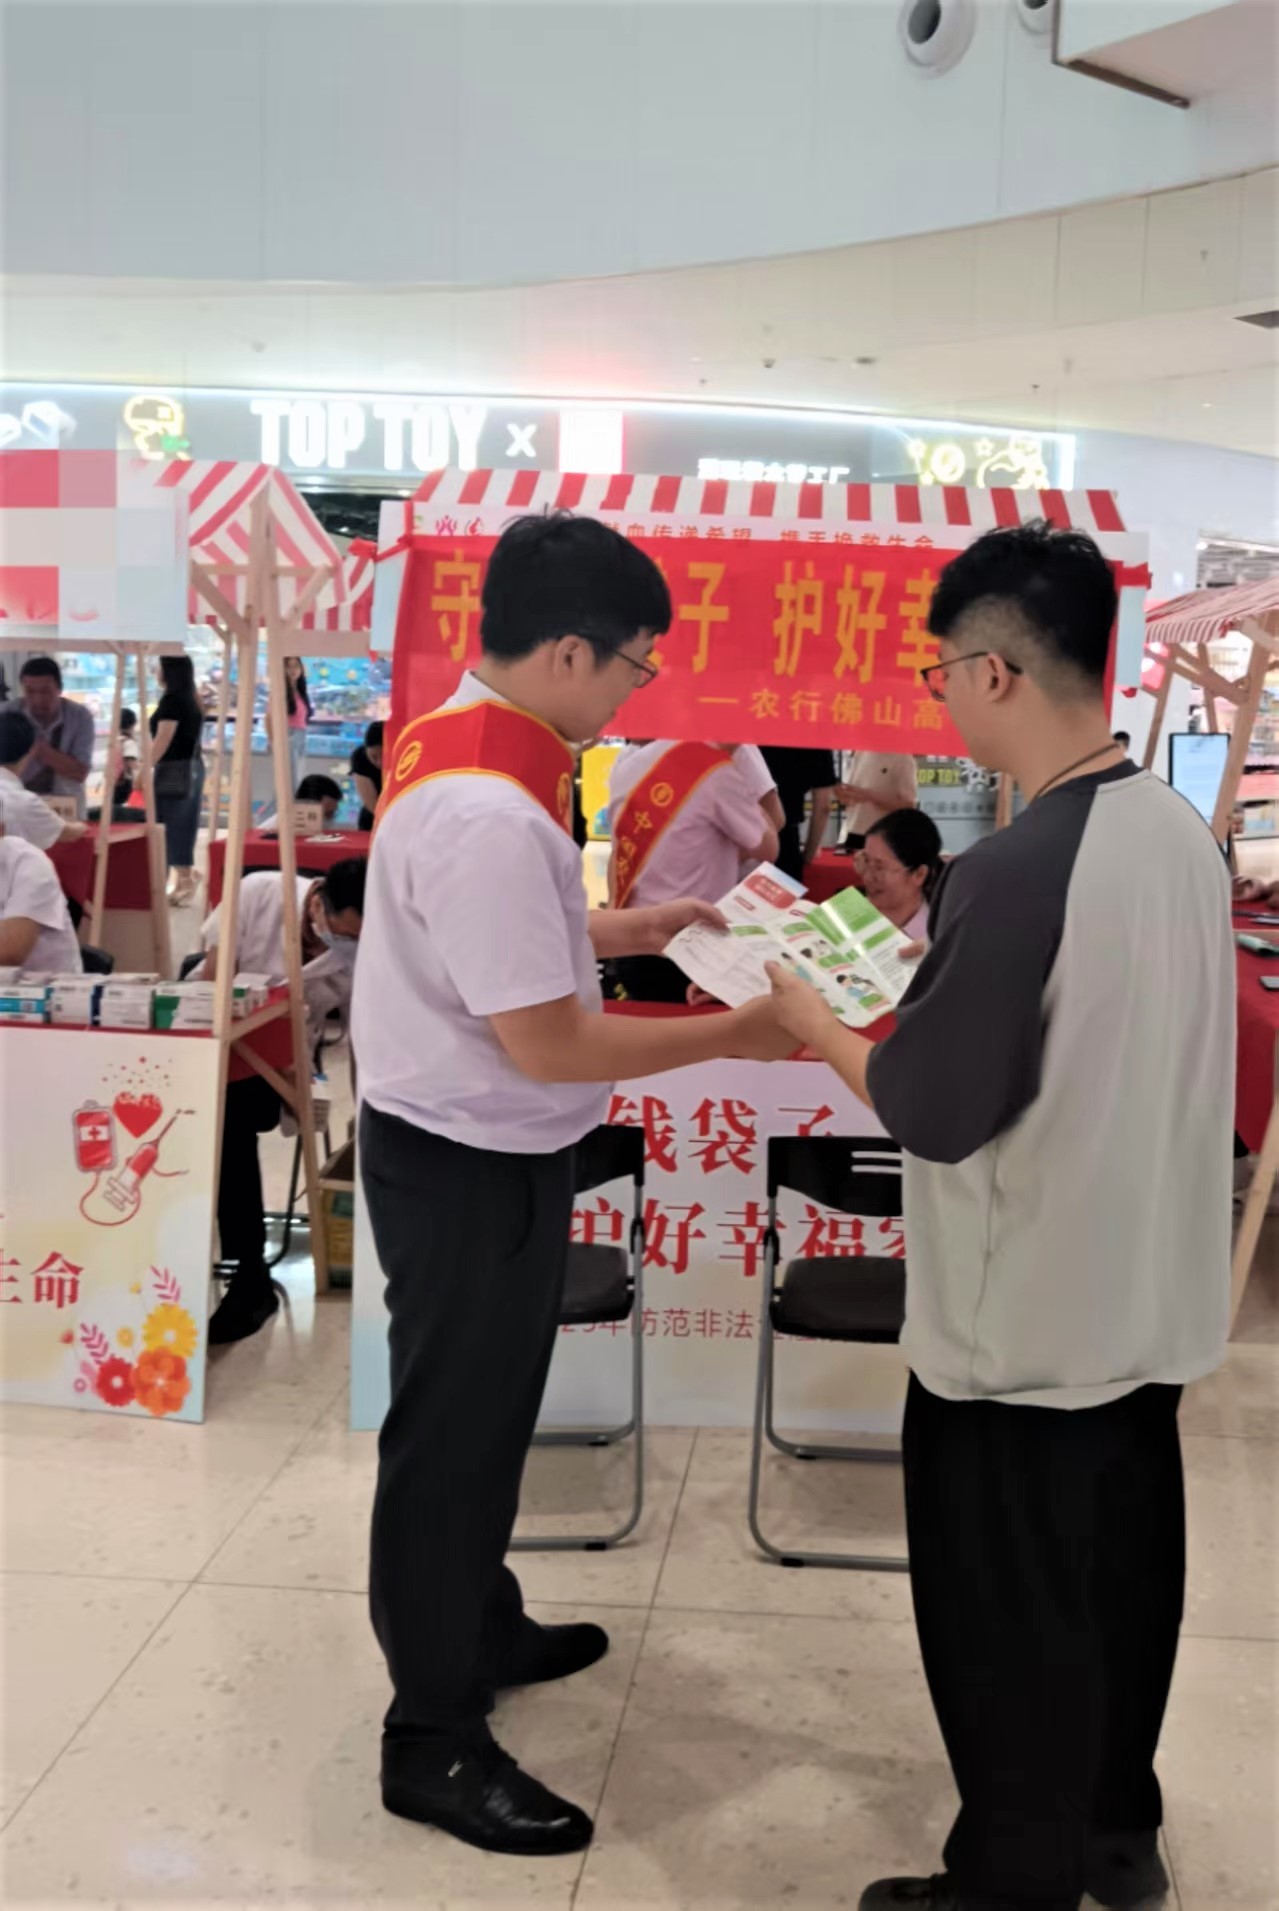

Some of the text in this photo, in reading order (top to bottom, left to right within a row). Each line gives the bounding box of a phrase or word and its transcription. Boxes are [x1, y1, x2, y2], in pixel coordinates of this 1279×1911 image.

[249, 400, 365, 469] TOP
[373, 403, 488, 473] TOY
[915, 768, 936, 785] OP
